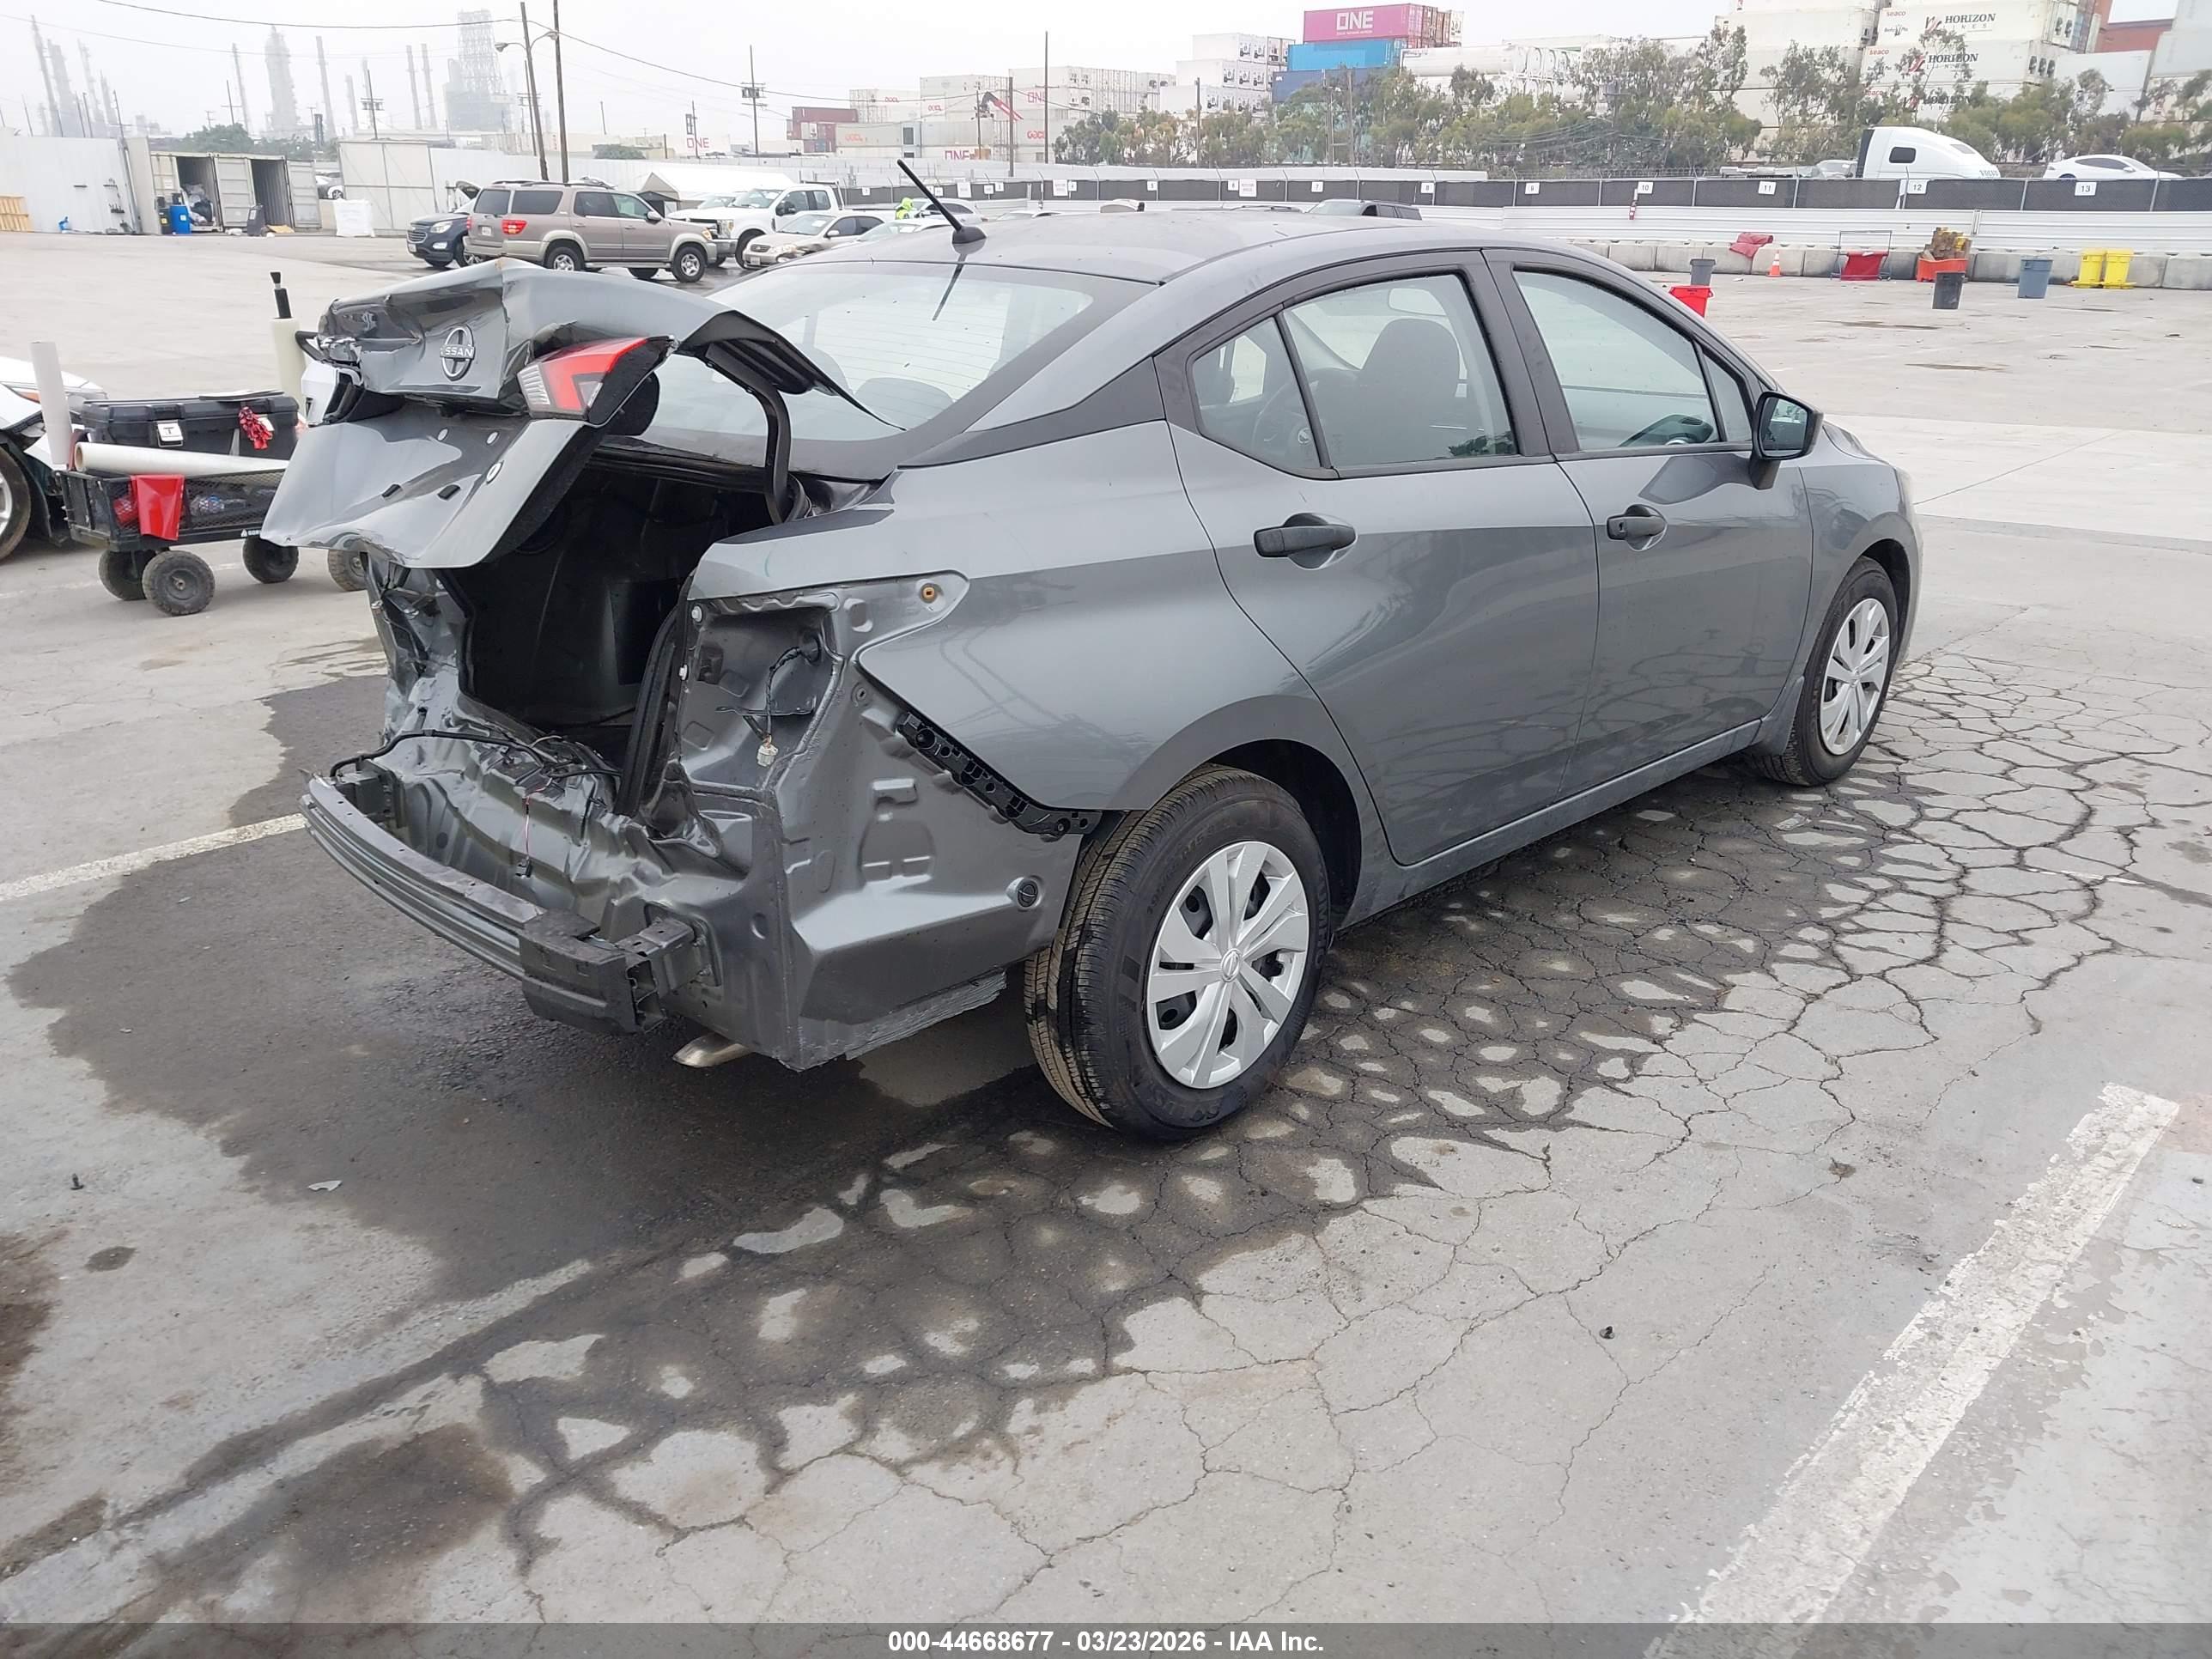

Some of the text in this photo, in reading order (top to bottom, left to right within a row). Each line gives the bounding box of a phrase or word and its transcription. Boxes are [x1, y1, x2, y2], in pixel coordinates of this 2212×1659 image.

[1336, 10, 1374, 30] ONE
[1944, 14, 1996, 24] HORIZON
[1928, 53, 1979, 64] HORIZON
[687, 137, 710, 149] ONE
[440, 345, 475, 358] SSAN
